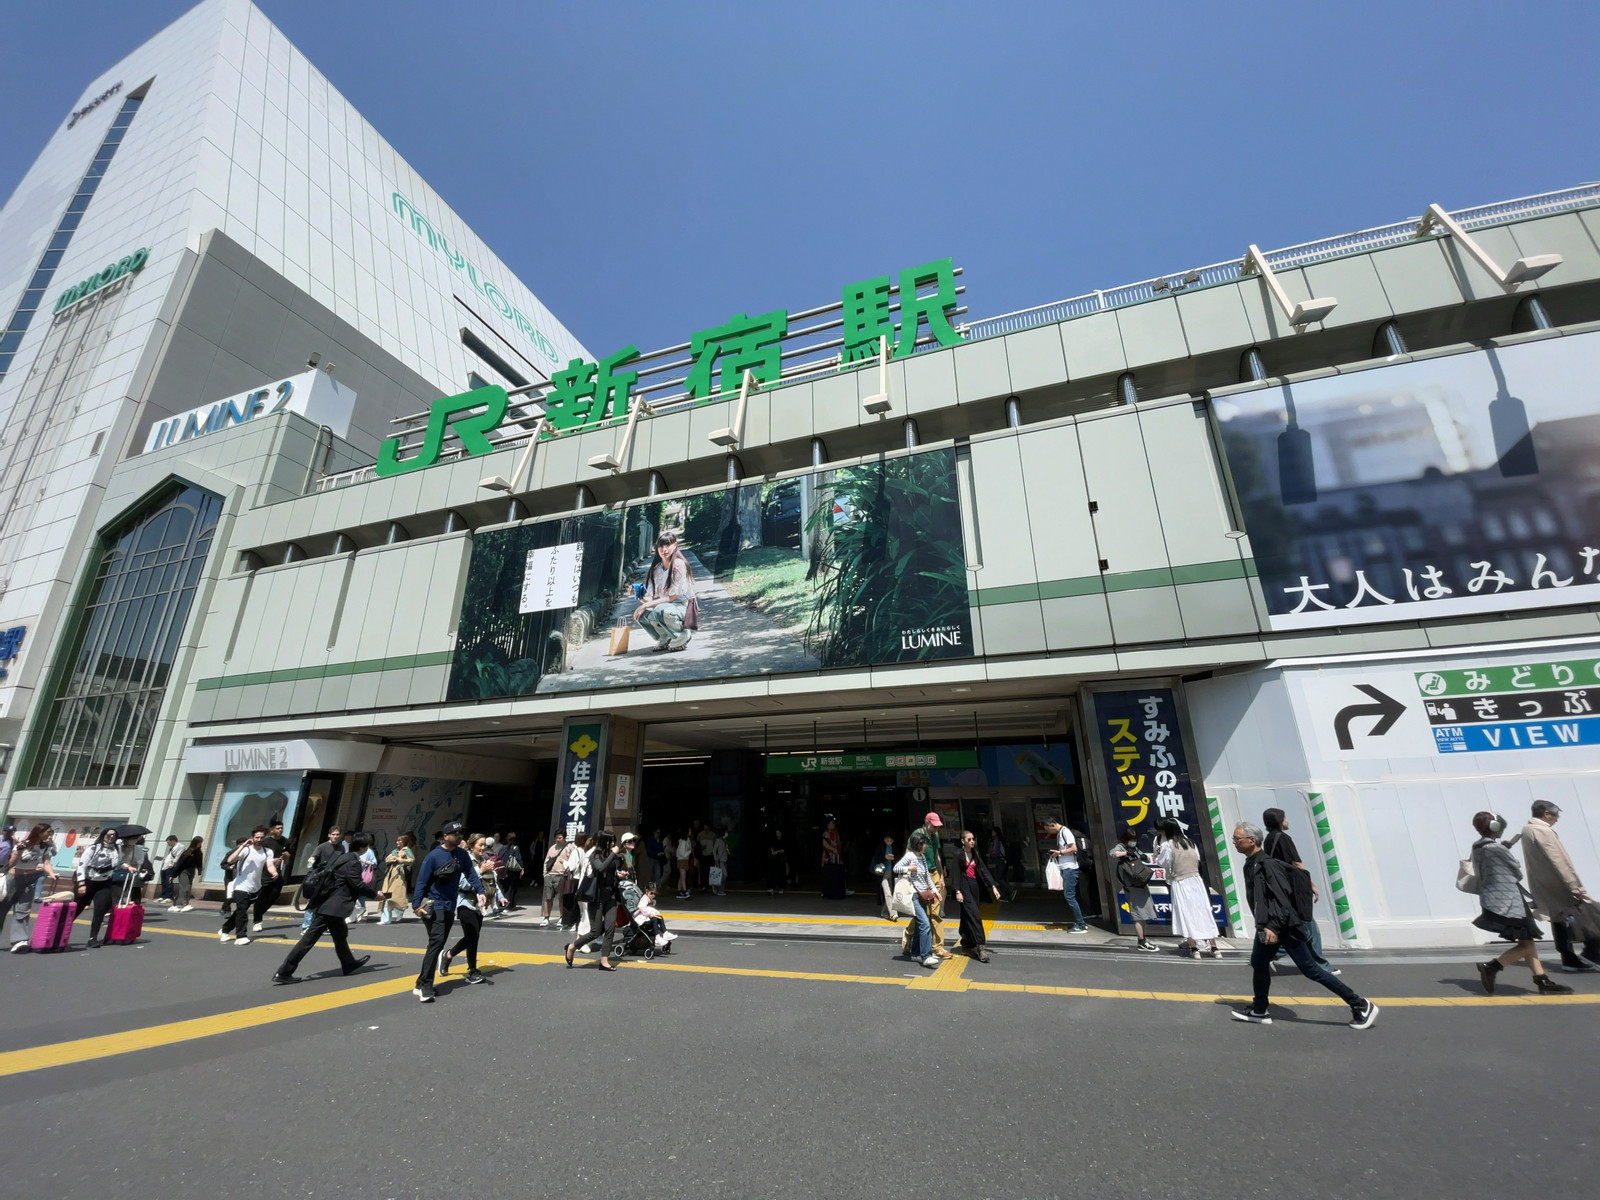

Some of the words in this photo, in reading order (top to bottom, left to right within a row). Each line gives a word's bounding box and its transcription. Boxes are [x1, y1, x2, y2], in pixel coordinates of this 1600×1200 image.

[269, 380, 296, 414] 2
[521, 550, 535, 609] 幸福にする。
[545, 546, 560, 608] ふたり以上を
[901, 631, 962, 650] LUMINE
[1473, 690, 1592, 720] きっぷ
[1435, 727, 1464, 738] ATM
[1482, 723, 1580, 748] VIEW
[224, 747, 277, 771] LUMINE
[279, 746, 289, 769] 2
[801, 757, 817, 768] JR
[1107, 718, 1151, 827] ステップ
